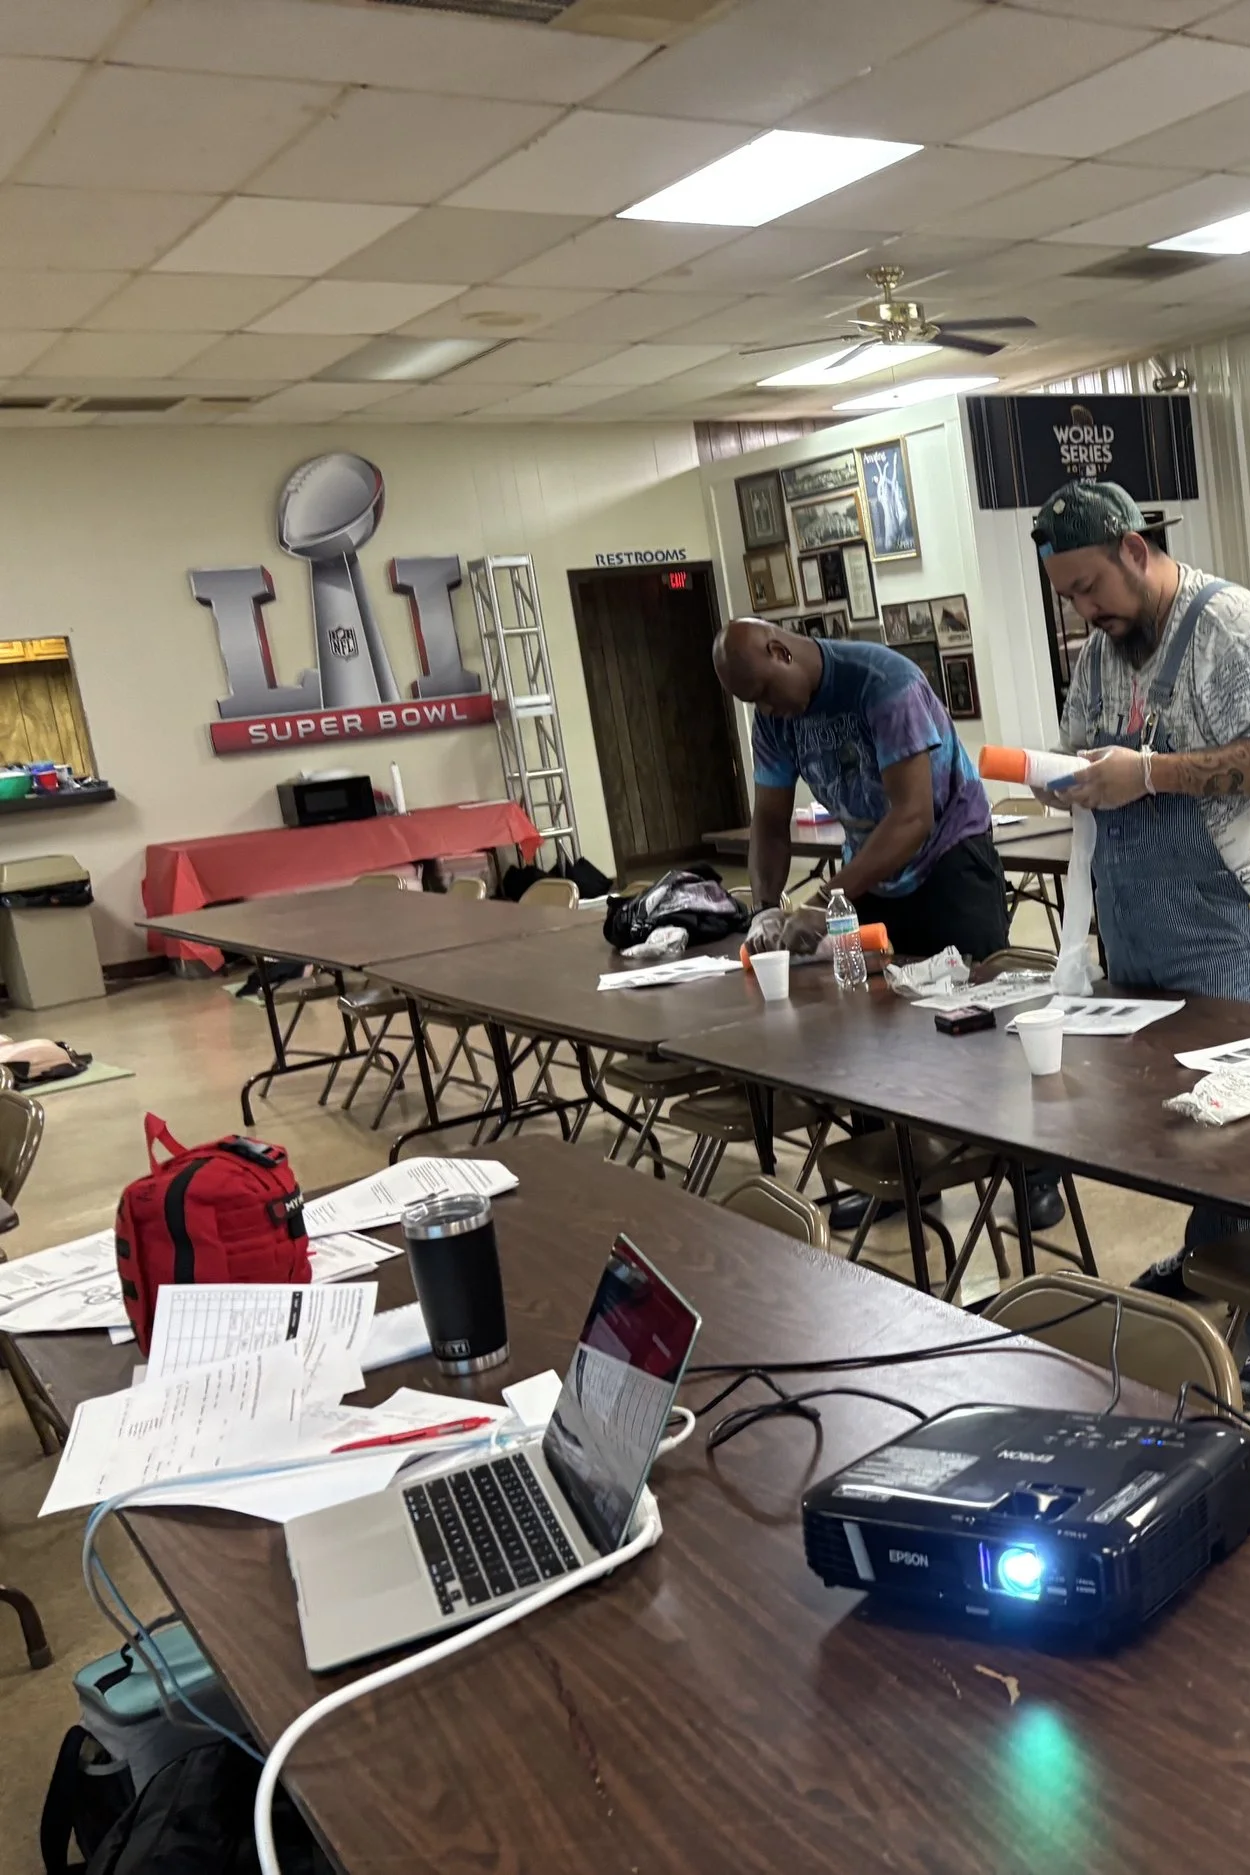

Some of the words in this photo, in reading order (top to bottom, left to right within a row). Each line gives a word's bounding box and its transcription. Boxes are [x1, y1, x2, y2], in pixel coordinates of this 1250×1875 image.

[1053, 425, 1114, 444] WORLD
[1060, 444, 1113, 463] SERIES
[595, 549, 687, 566] RESTROOMS
[332, 636, 355, 654] NFL
[248, 714, 364, 744] SUPER
[378, 704, 468, 730] BOWL
[889, 1549, 929, 1568] EPSON
